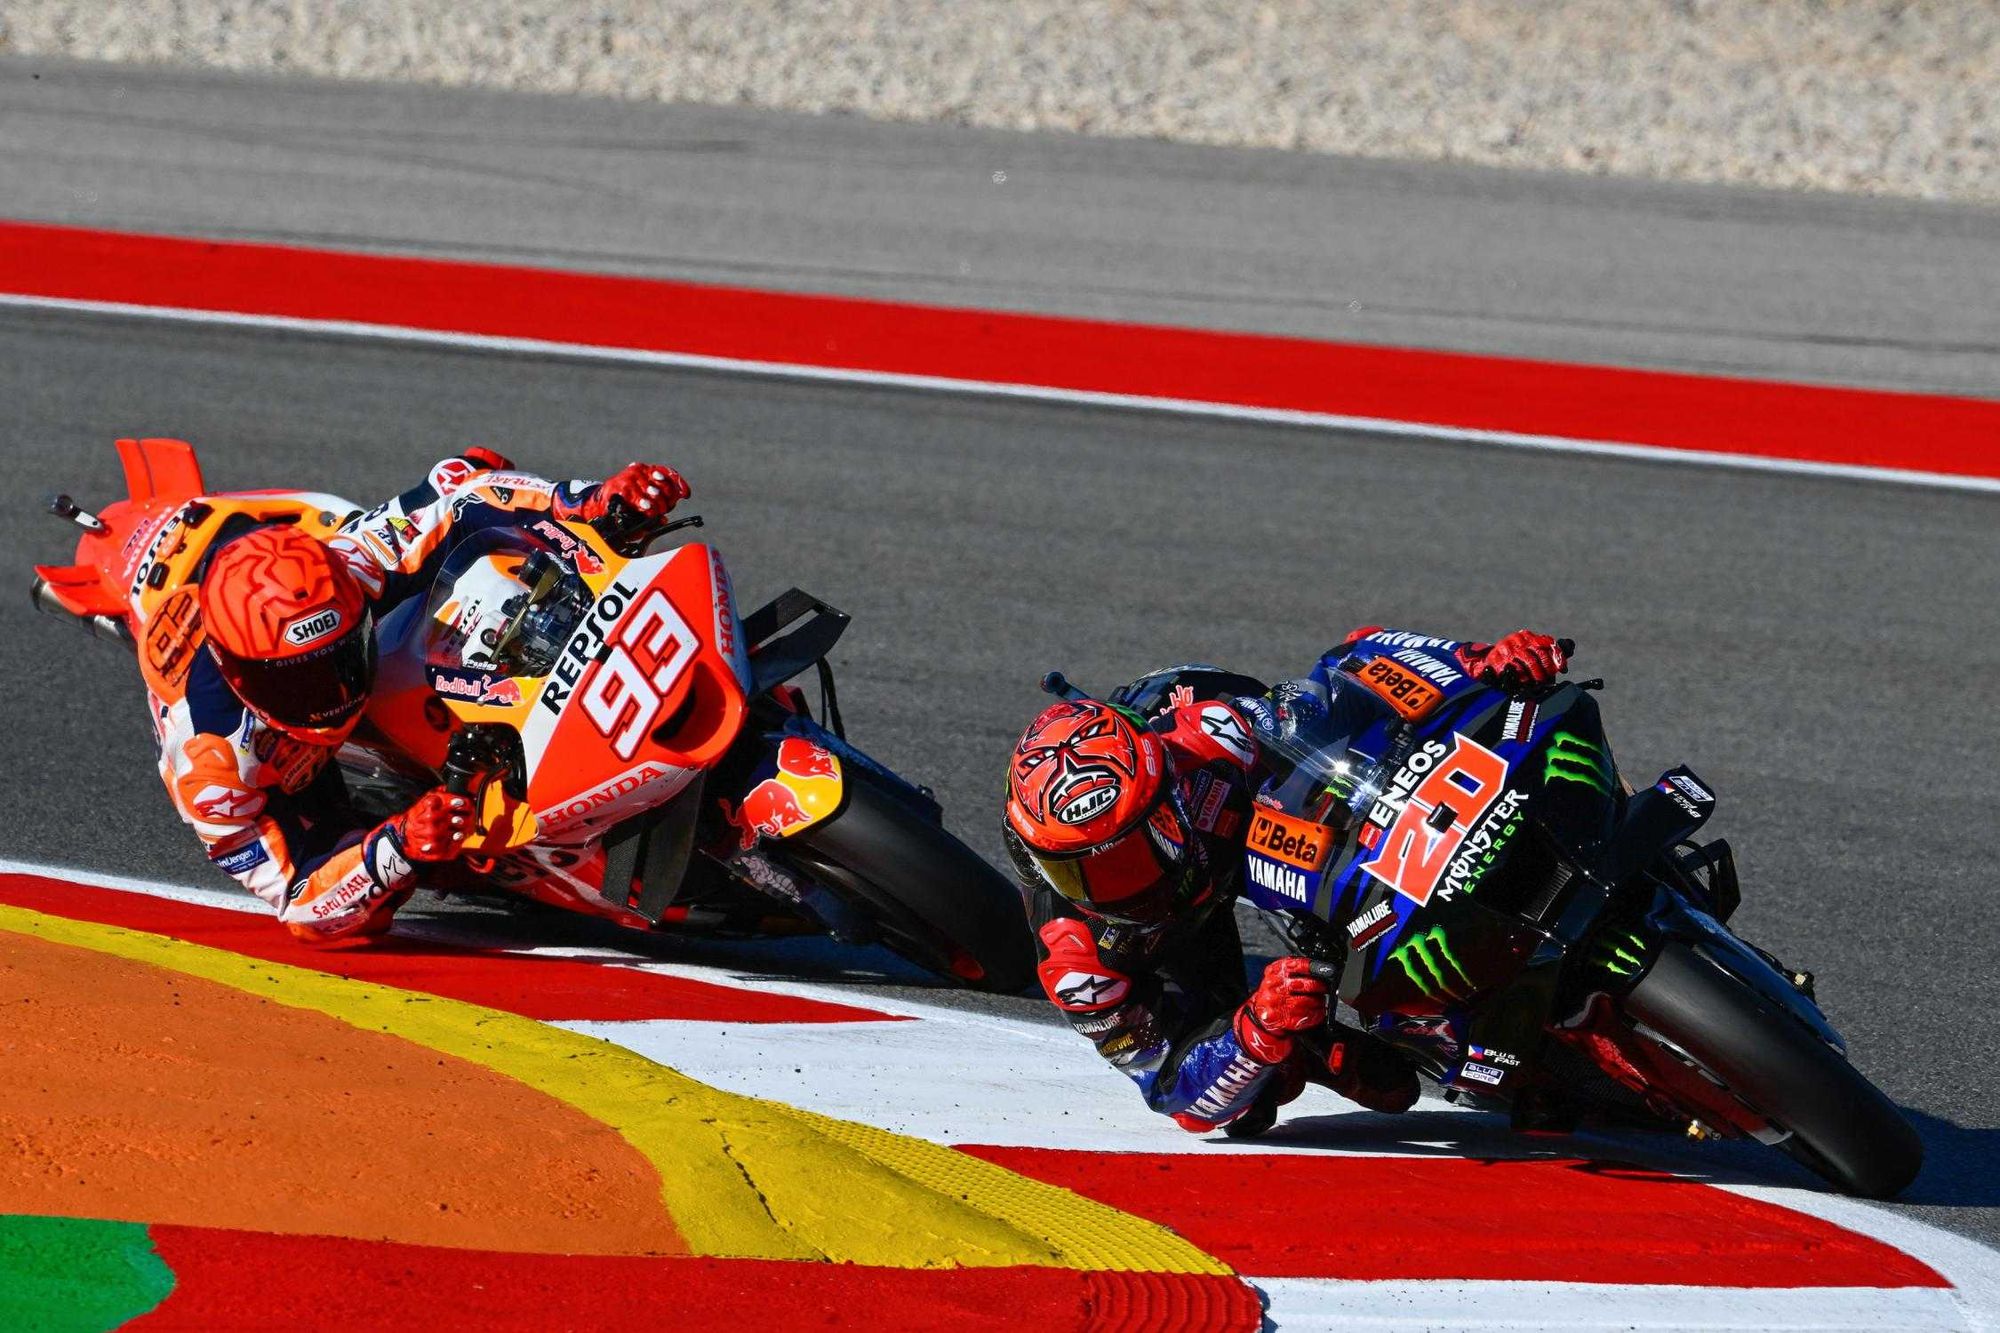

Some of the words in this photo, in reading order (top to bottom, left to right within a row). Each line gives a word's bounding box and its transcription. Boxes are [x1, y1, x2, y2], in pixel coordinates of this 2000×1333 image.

[131, 505, 190, 596] EPSOL
[292, 612, 337, 642] SHOEI
[541, 581, 638, 716] REPSOL
[579, 586, 704, 762] 93
[1368, 661, 1418, 701] Beta
[1392, 648, 1463, 688] YAMAHA
[1501, 700, 1526, 740] YAMALUBE
[540, 766, 666, 828] HONDA
[1066, 787, 1113, 821] HJC
[1369, 740, 1447, 828] ENEOS
[1358, 731, 1510, 908] 20
[1267, 822, 1318, 863] Beta
[1436, 788, 1530, 902] MONSTER
[1462, 810, 1525, 894] ENERGY
[1247, 854, 1307, 904] YAMAHA
[312, 894, 340, 919] Satu
[1346, 900, 1392, 938] YAMALUBE
[1468, 1063, 1500, 1077] BLUE
[1494, 1056, 1521, 1067] FAST
[1184, 1053, 1264, 1119] YAMAHA
